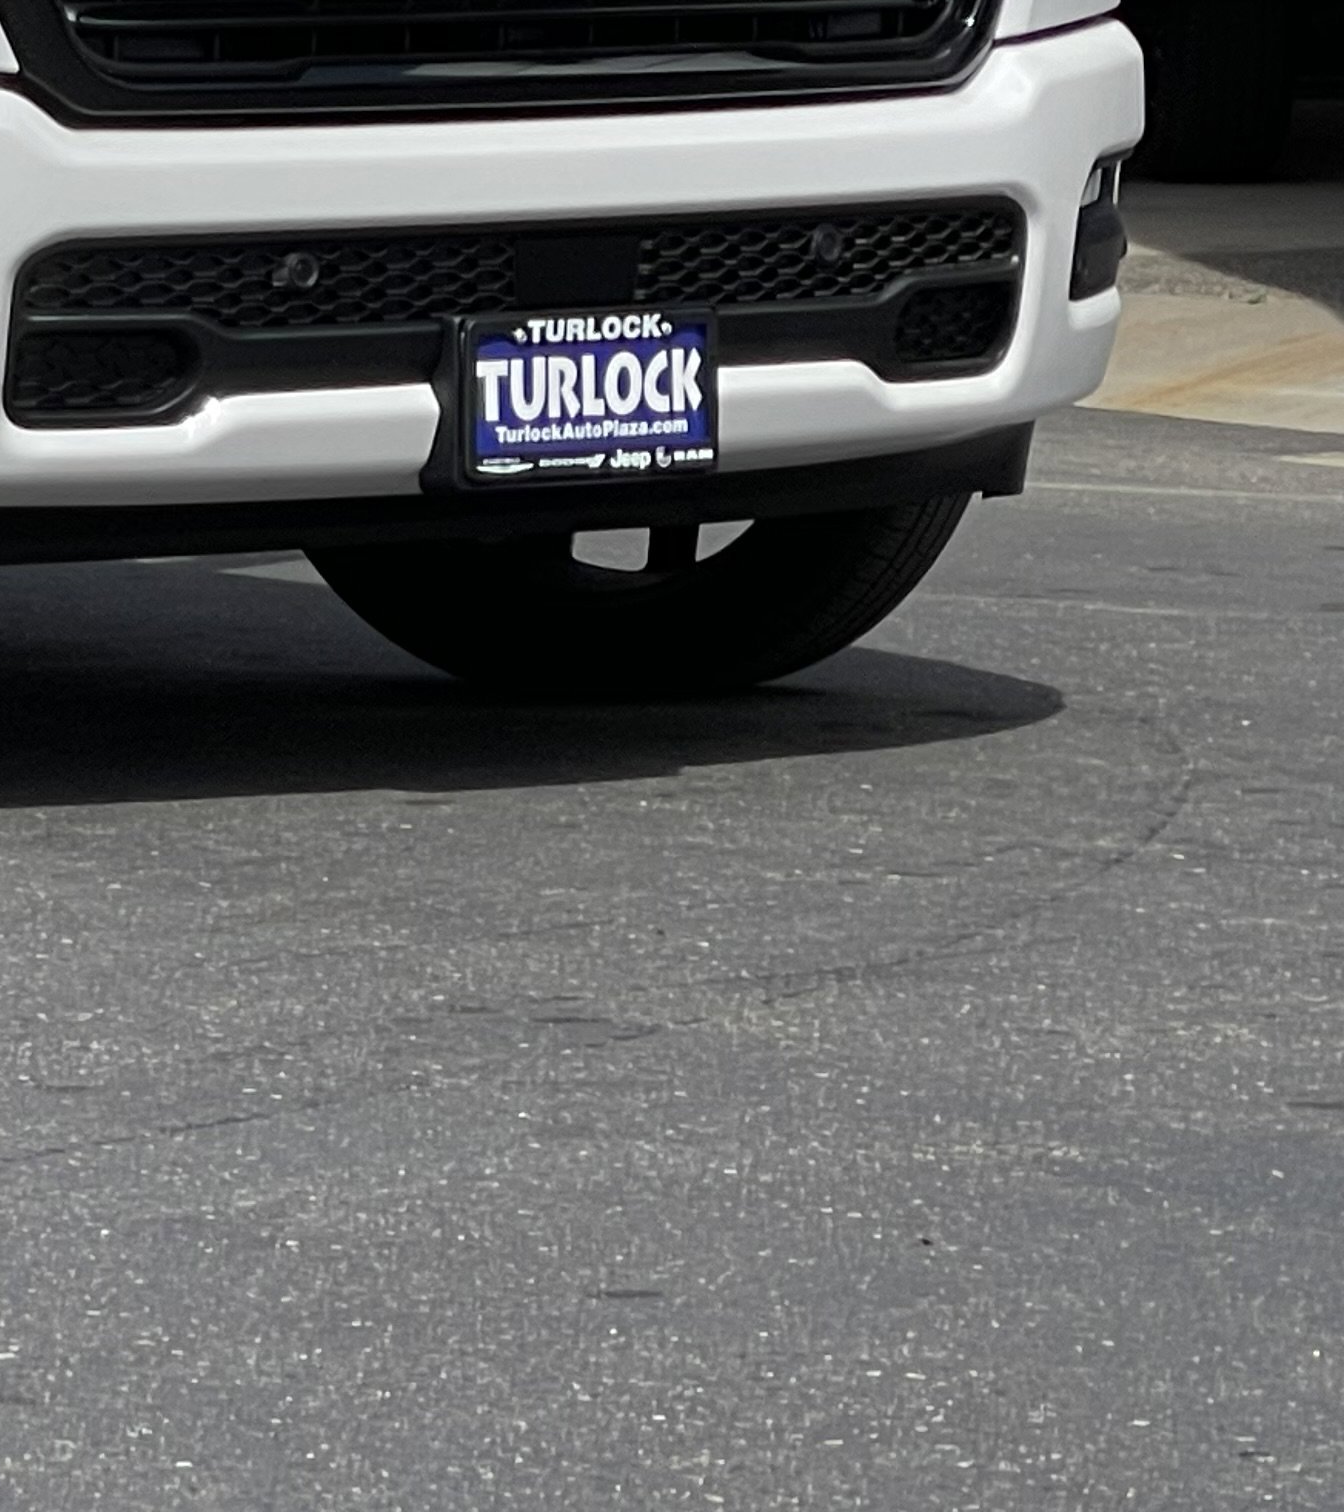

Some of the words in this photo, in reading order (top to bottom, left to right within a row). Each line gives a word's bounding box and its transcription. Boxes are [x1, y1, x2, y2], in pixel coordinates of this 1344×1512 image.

[526, 314, 662, 343] TURLOCK
[476, 347, 703, 422] TURLOCK
[495, 419, 689, 443] TurlockAutoPlaza.com
[610, 449, 652, 469] Jeep
[673, 449, 714, 461] RAM
